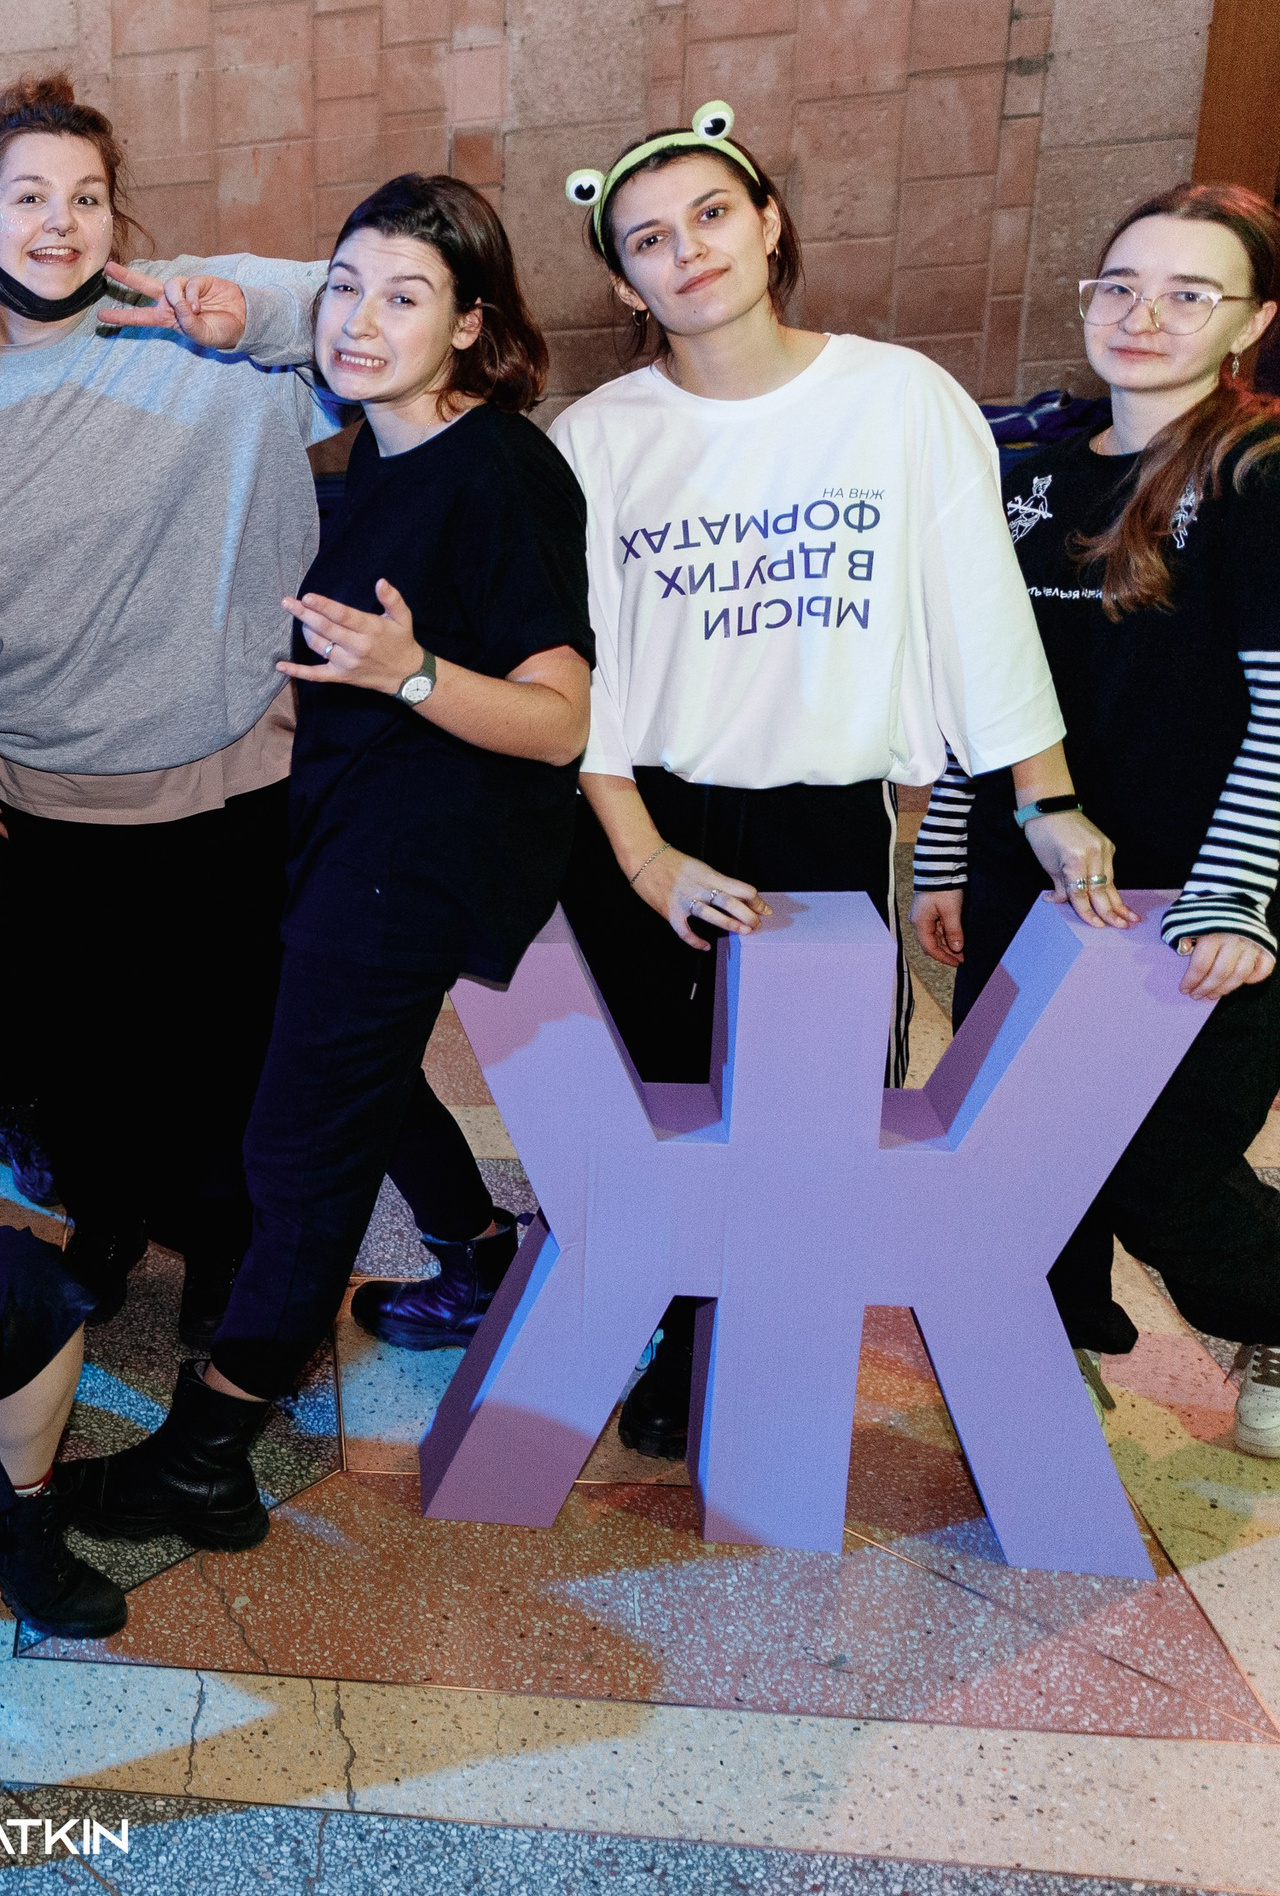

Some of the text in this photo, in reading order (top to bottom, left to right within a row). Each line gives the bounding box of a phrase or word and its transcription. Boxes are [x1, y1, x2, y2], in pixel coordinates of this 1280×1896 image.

[822, 487, 885, 501] НА ВНЖ
[619, 499, 881, 565] ФОРМАТАХ
[654, 541, 875, 600] В ДРУГИХ
[704, 595, 870, 641] МЫСЛИ
